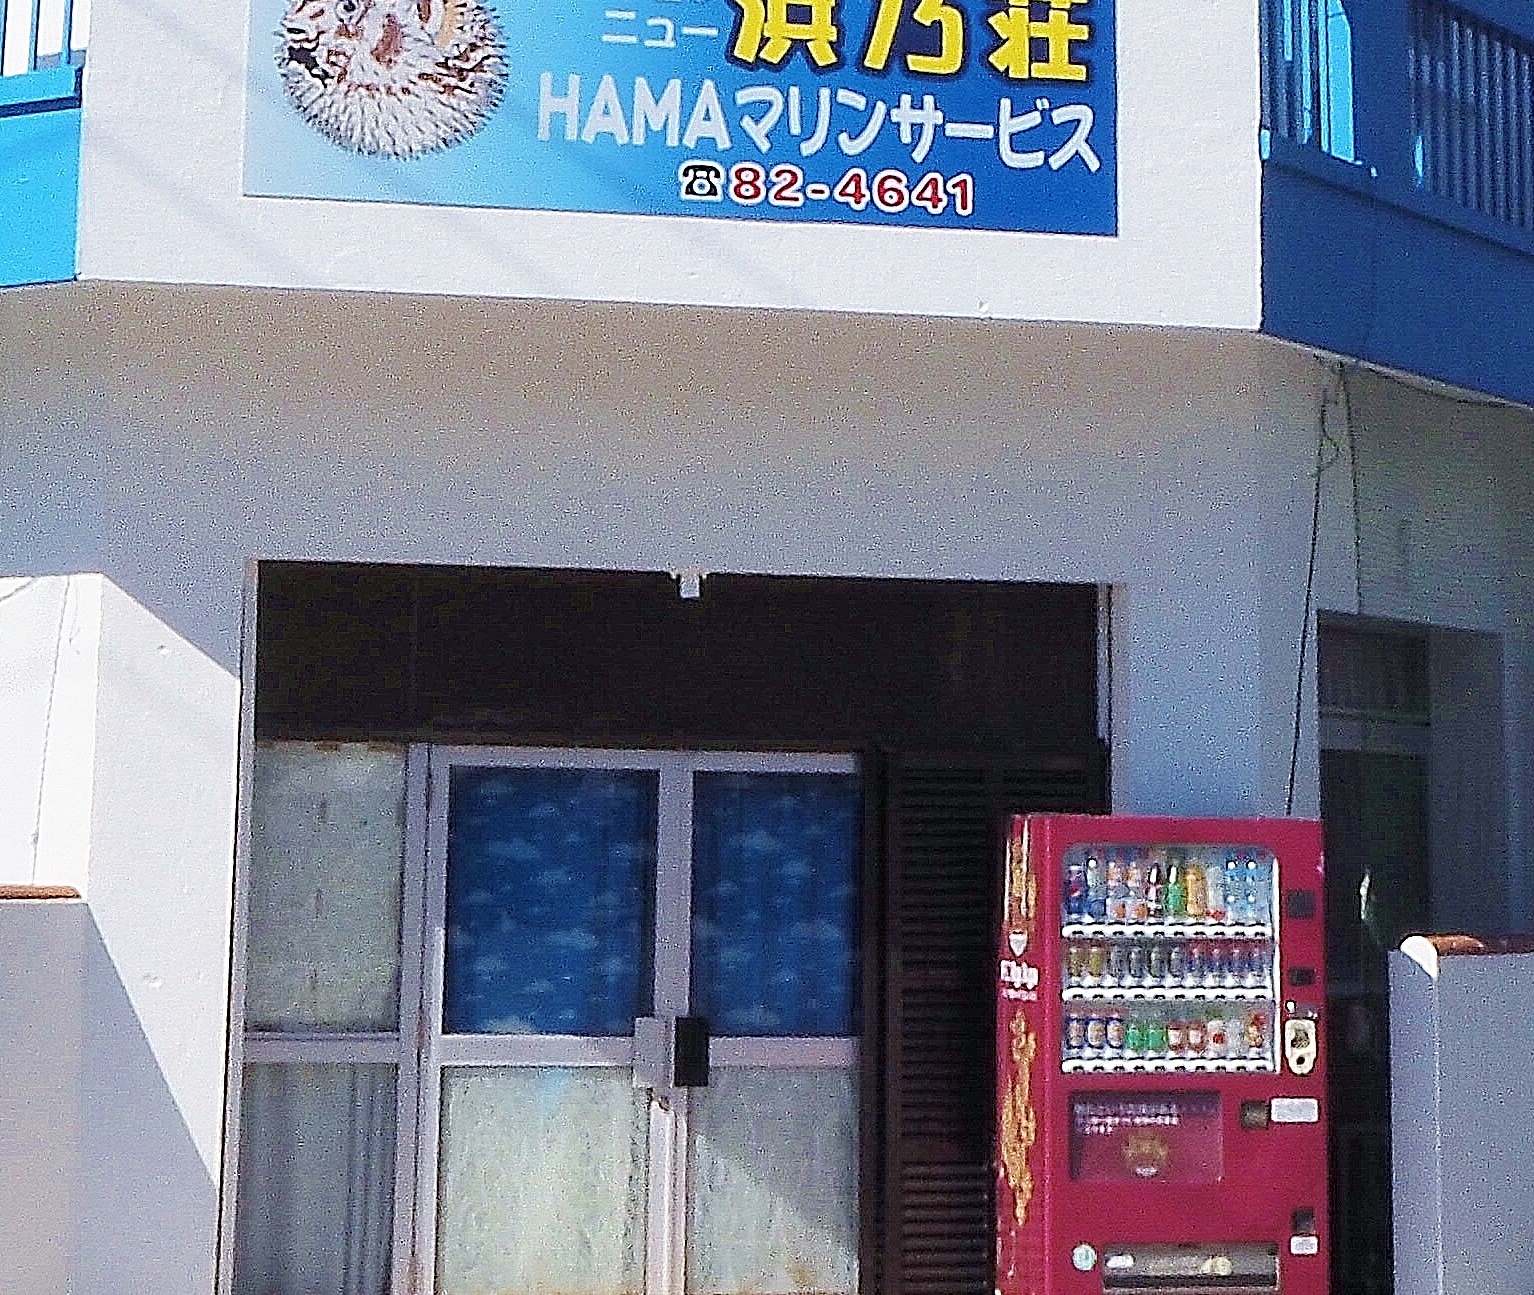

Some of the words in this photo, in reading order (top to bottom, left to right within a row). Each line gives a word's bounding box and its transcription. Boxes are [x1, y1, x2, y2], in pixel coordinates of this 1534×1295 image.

[601, 8, 720, 49] ニュー
[731, 164, 972, 214] 82-4641
